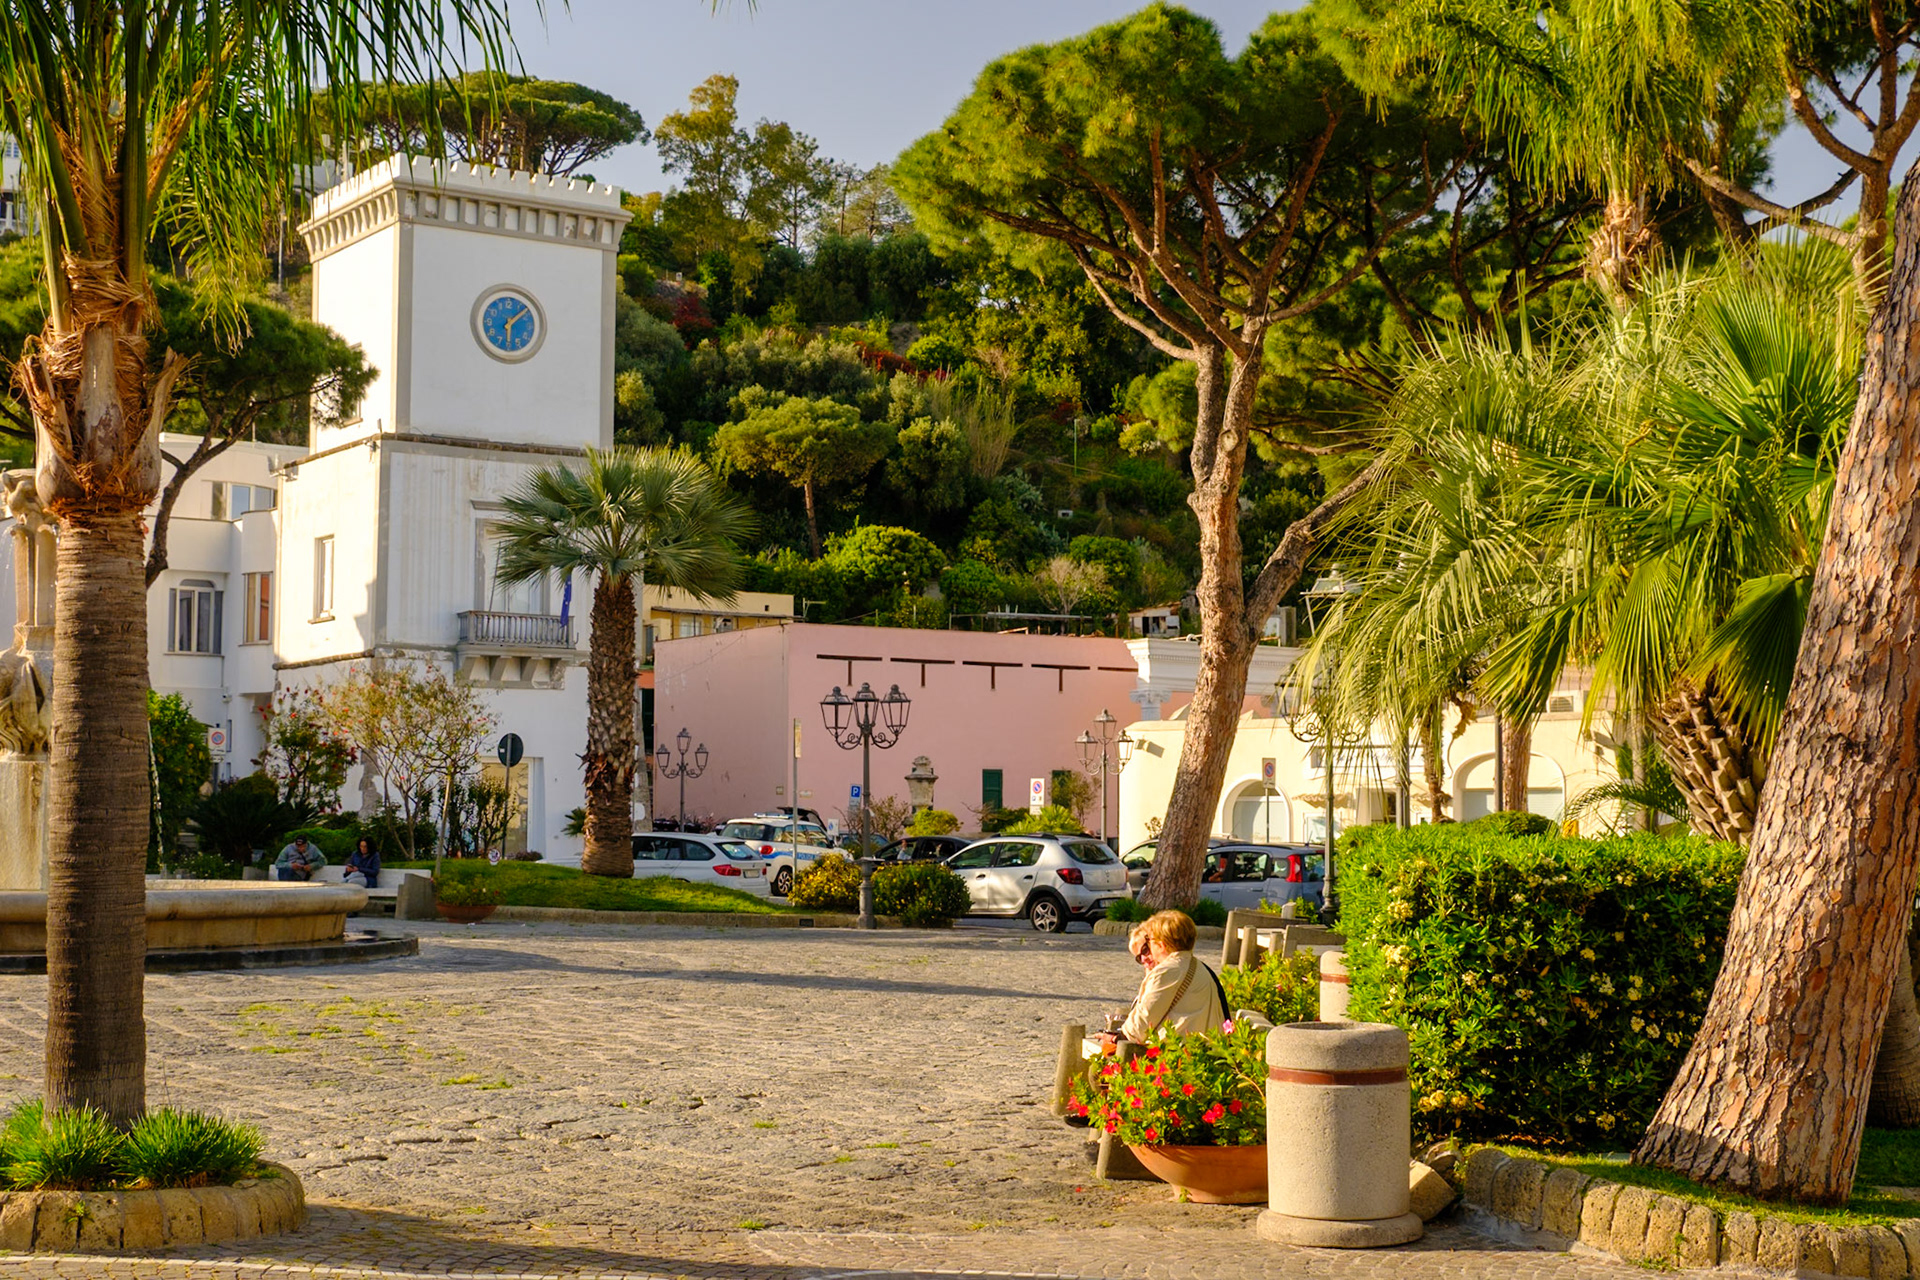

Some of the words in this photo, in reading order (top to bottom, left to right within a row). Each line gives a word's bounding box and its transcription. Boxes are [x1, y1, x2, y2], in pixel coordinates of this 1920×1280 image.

[505, 301, 512, 309] 12
[486, 318, 492, 326] 9
[489, 328, 495, 336] 8
[522, 332, 528, 340] 4
[496, 336, 503, 344] 7
[515, 338, 521, 346] 5
[852, 787, 858, 796] P
